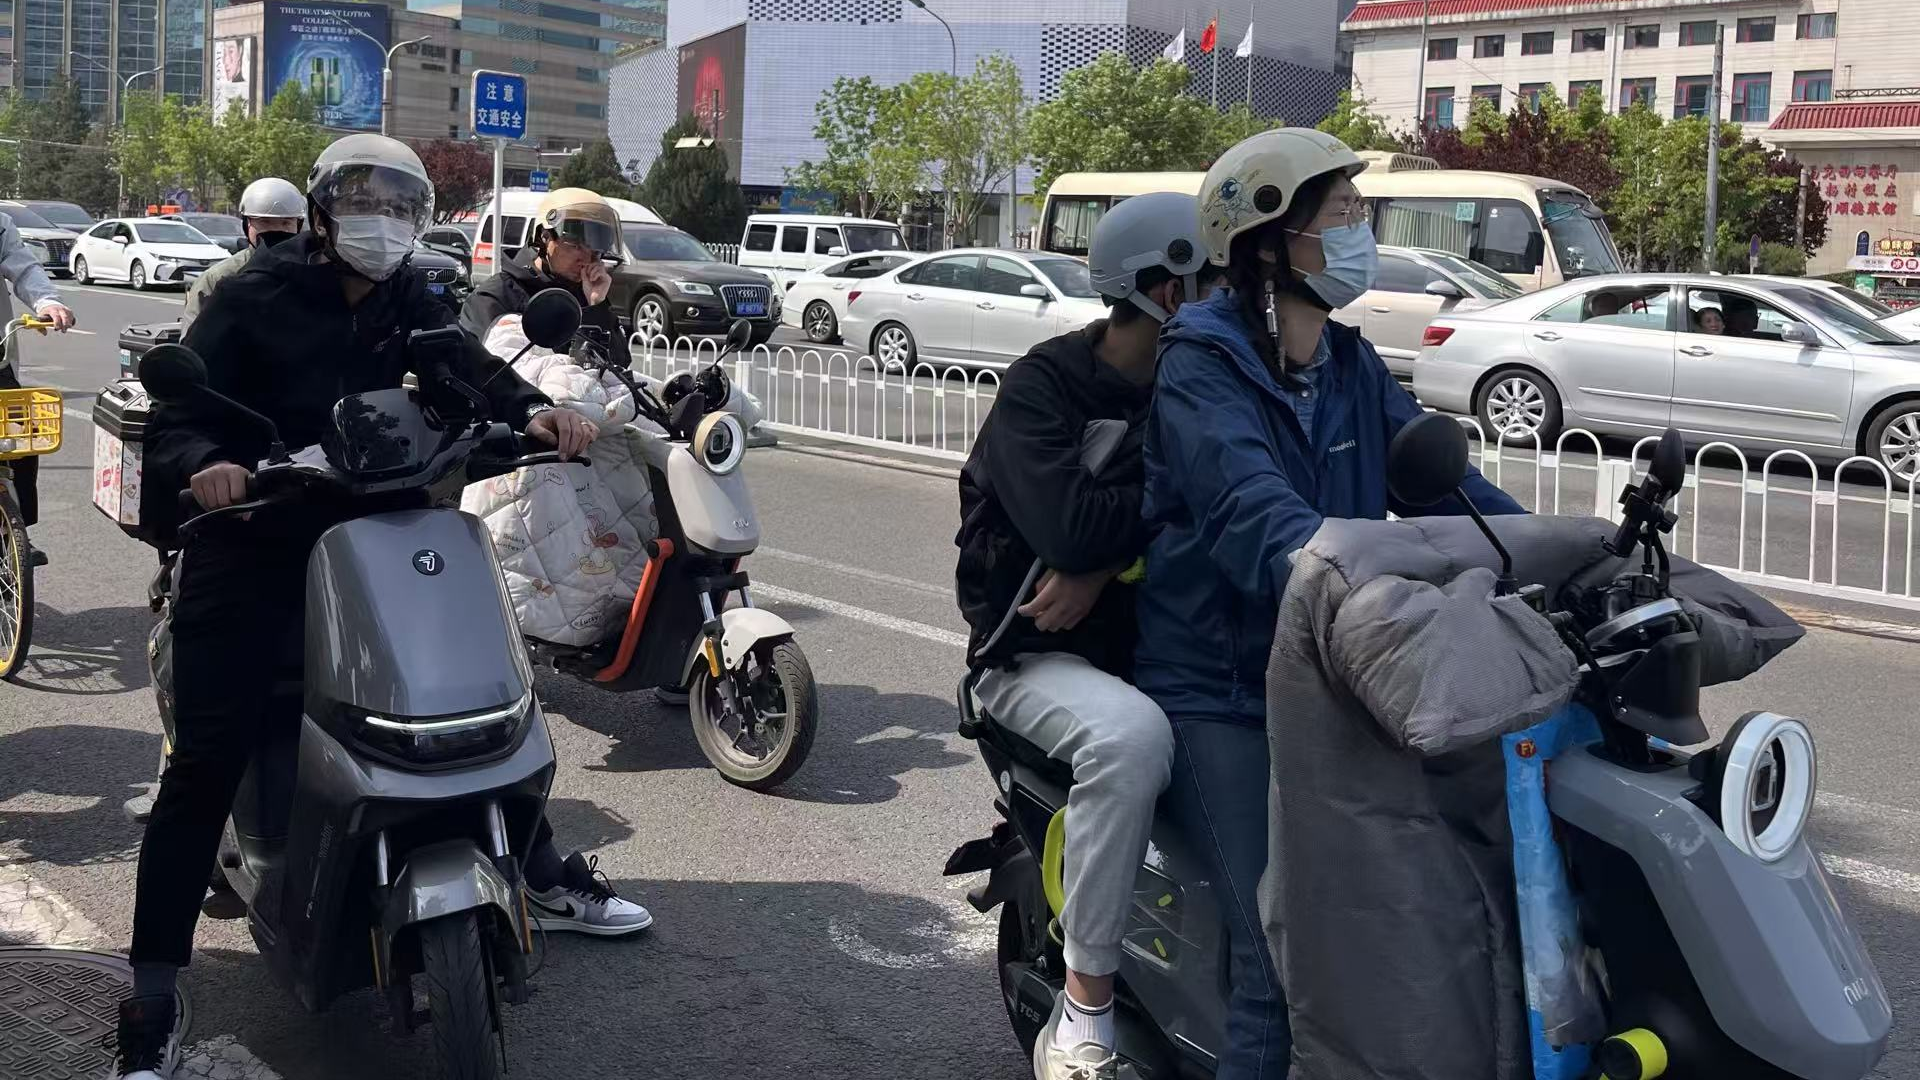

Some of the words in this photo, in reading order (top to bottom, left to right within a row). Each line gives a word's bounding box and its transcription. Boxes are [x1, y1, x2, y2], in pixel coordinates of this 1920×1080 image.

[343, 10, 371, 18] LOTION
[486, 82, 514, 102] 注意
[477, 107, 522, 129] 交通安全
